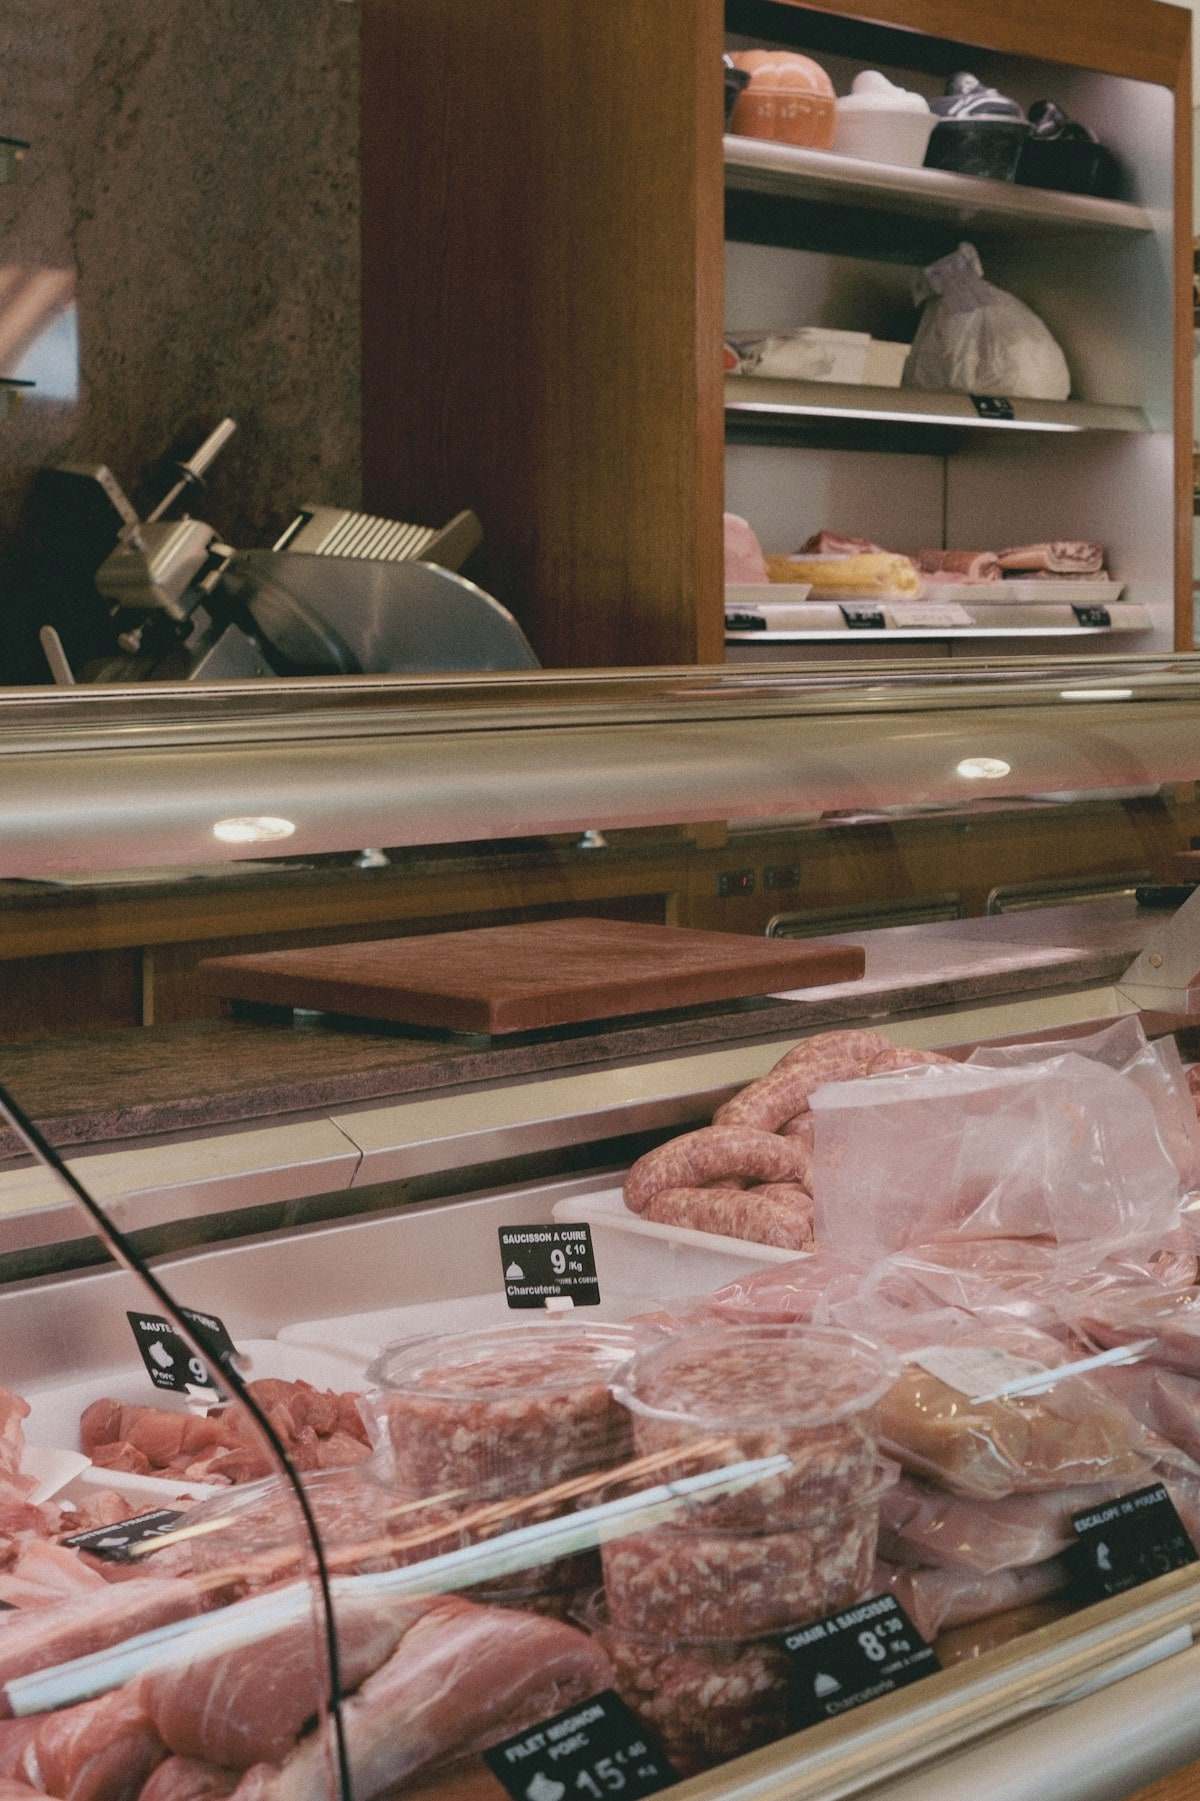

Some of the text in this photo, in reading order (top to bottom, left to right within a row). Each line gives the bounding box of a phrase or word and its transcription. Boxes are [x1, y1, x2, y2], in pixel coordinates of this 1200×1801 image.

[502, 1230, 588, 1245] SAUCISSON A CUIRE
[550, 1248, 566, 1275] 9
[507, 1284, 561, 1297] Charcuterie
[188, 1357, 209, 1384] 9
[1073, 1506, 1121, 1534] ESCALOPE
[1133, 1487, 1169, 1508] POULET
[784, 1595, 898, 1651] CHAIR A SAUCISSE
[857, 1630, 887, 1662] 8
[504, 1703, 606, 1763] FILET MIGNON
[547, 1731, 591, 1761] PORC
[575, 1757, 627, 1799] 15
